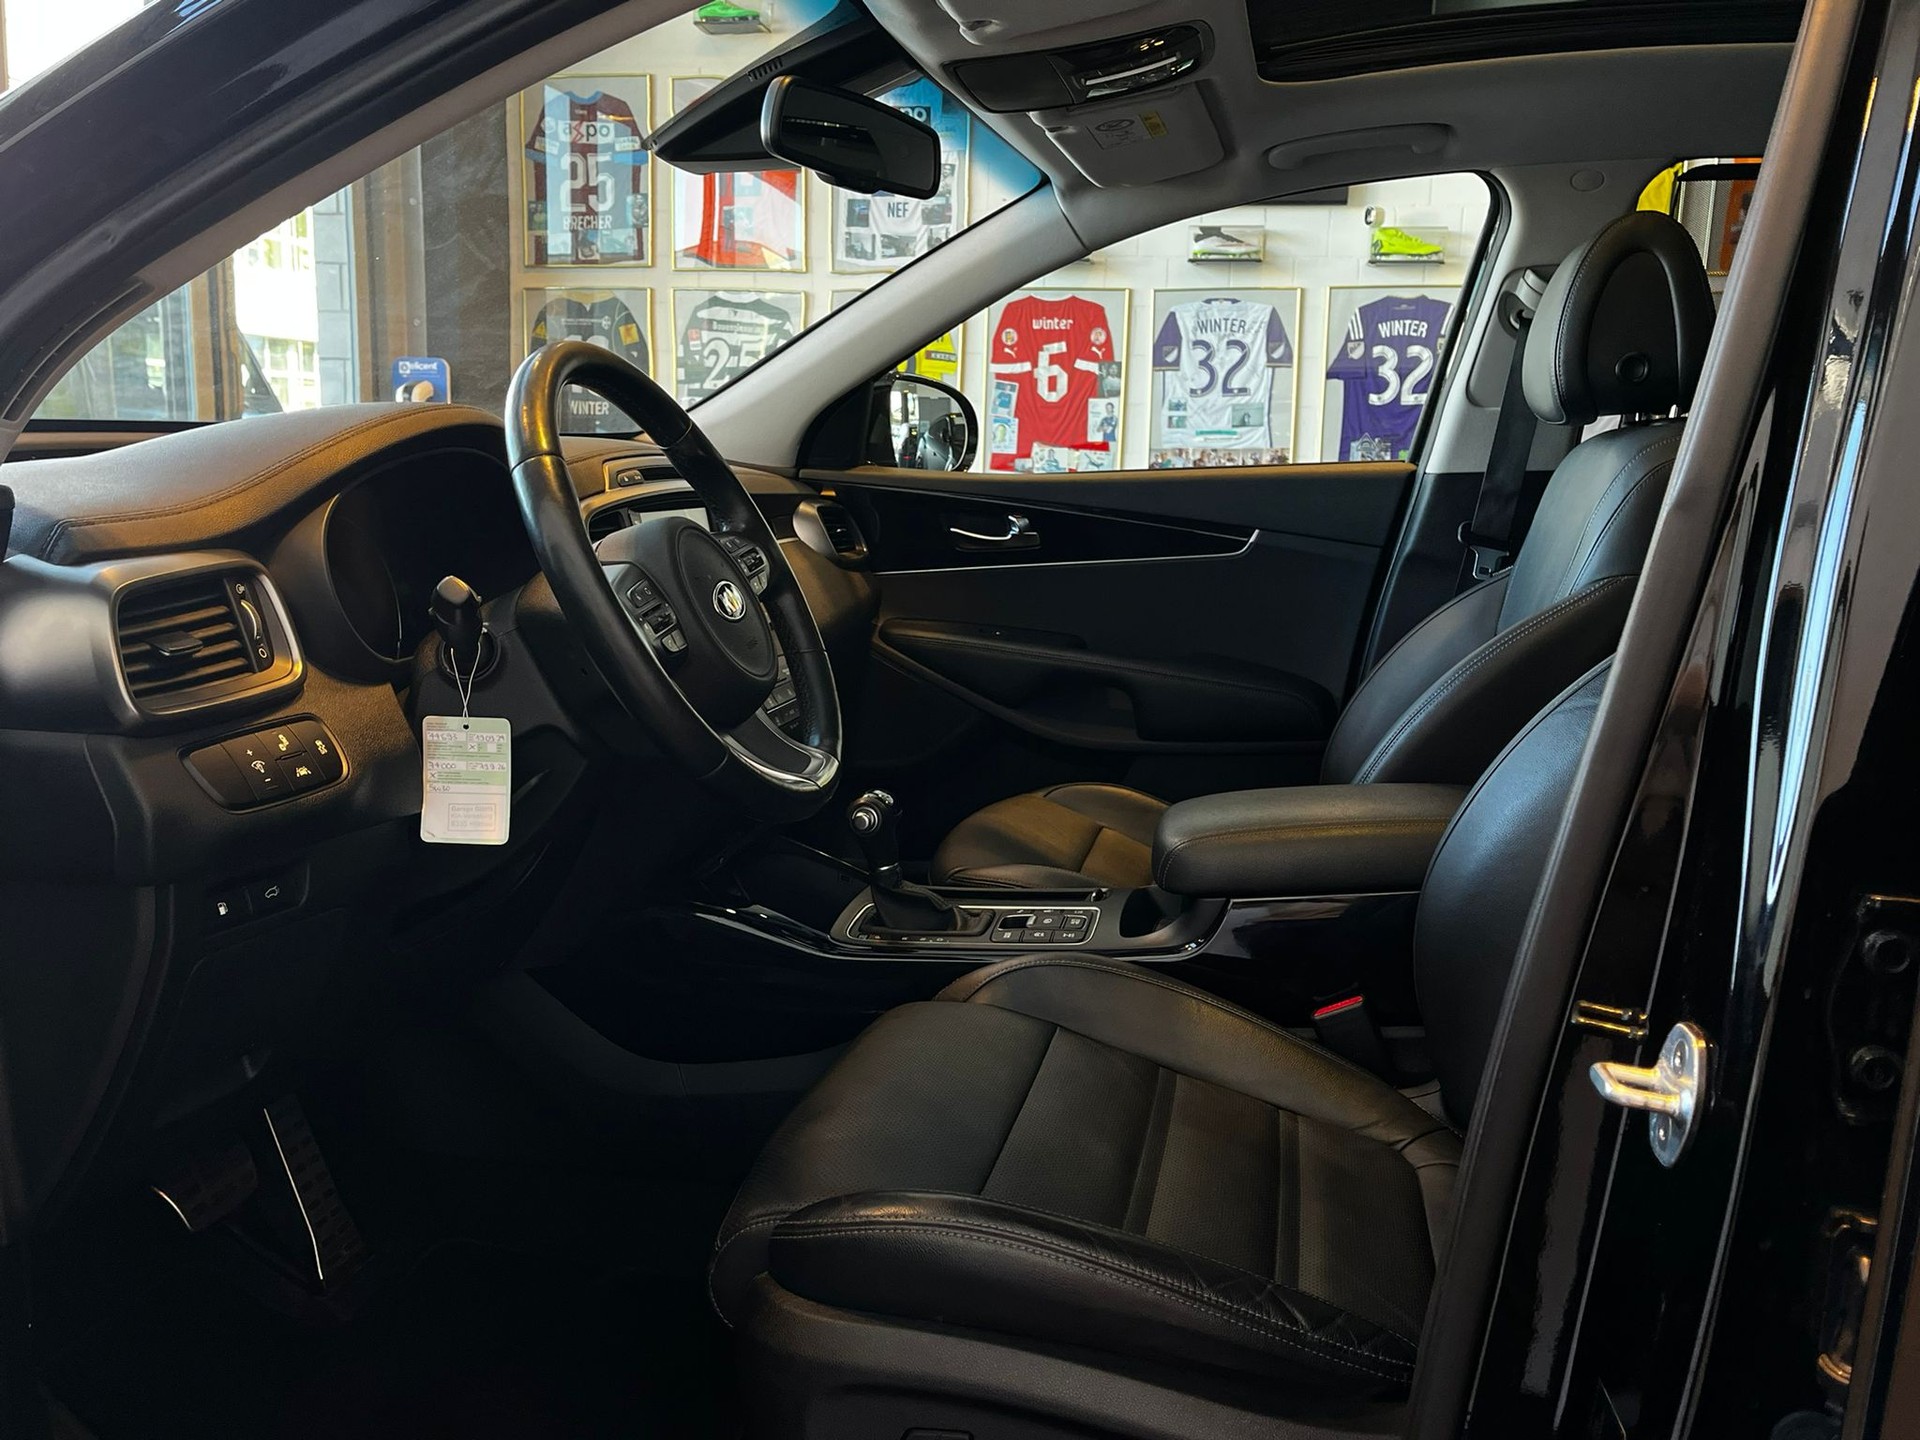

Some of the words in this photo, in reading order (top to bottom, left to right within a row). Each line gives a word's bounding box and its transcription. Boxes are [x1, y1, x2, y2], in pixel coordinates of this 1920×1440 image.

[560, 152, 615, 212] 25
[887, 202, 909, 218] NEF
[562, 215, 613, 231] BRECHER
[1032, 317, 1074, 330] winter
[1196, 318, 1247, 335] WINTER
[1377, 320, 1428, 338] WINTER
[1033, 341, 1069, 403] 6
[1188, 339, 1251, 398] 32
[1367, 344, 1434, 406] 32
[568, 400, 610, 416] WINTER
